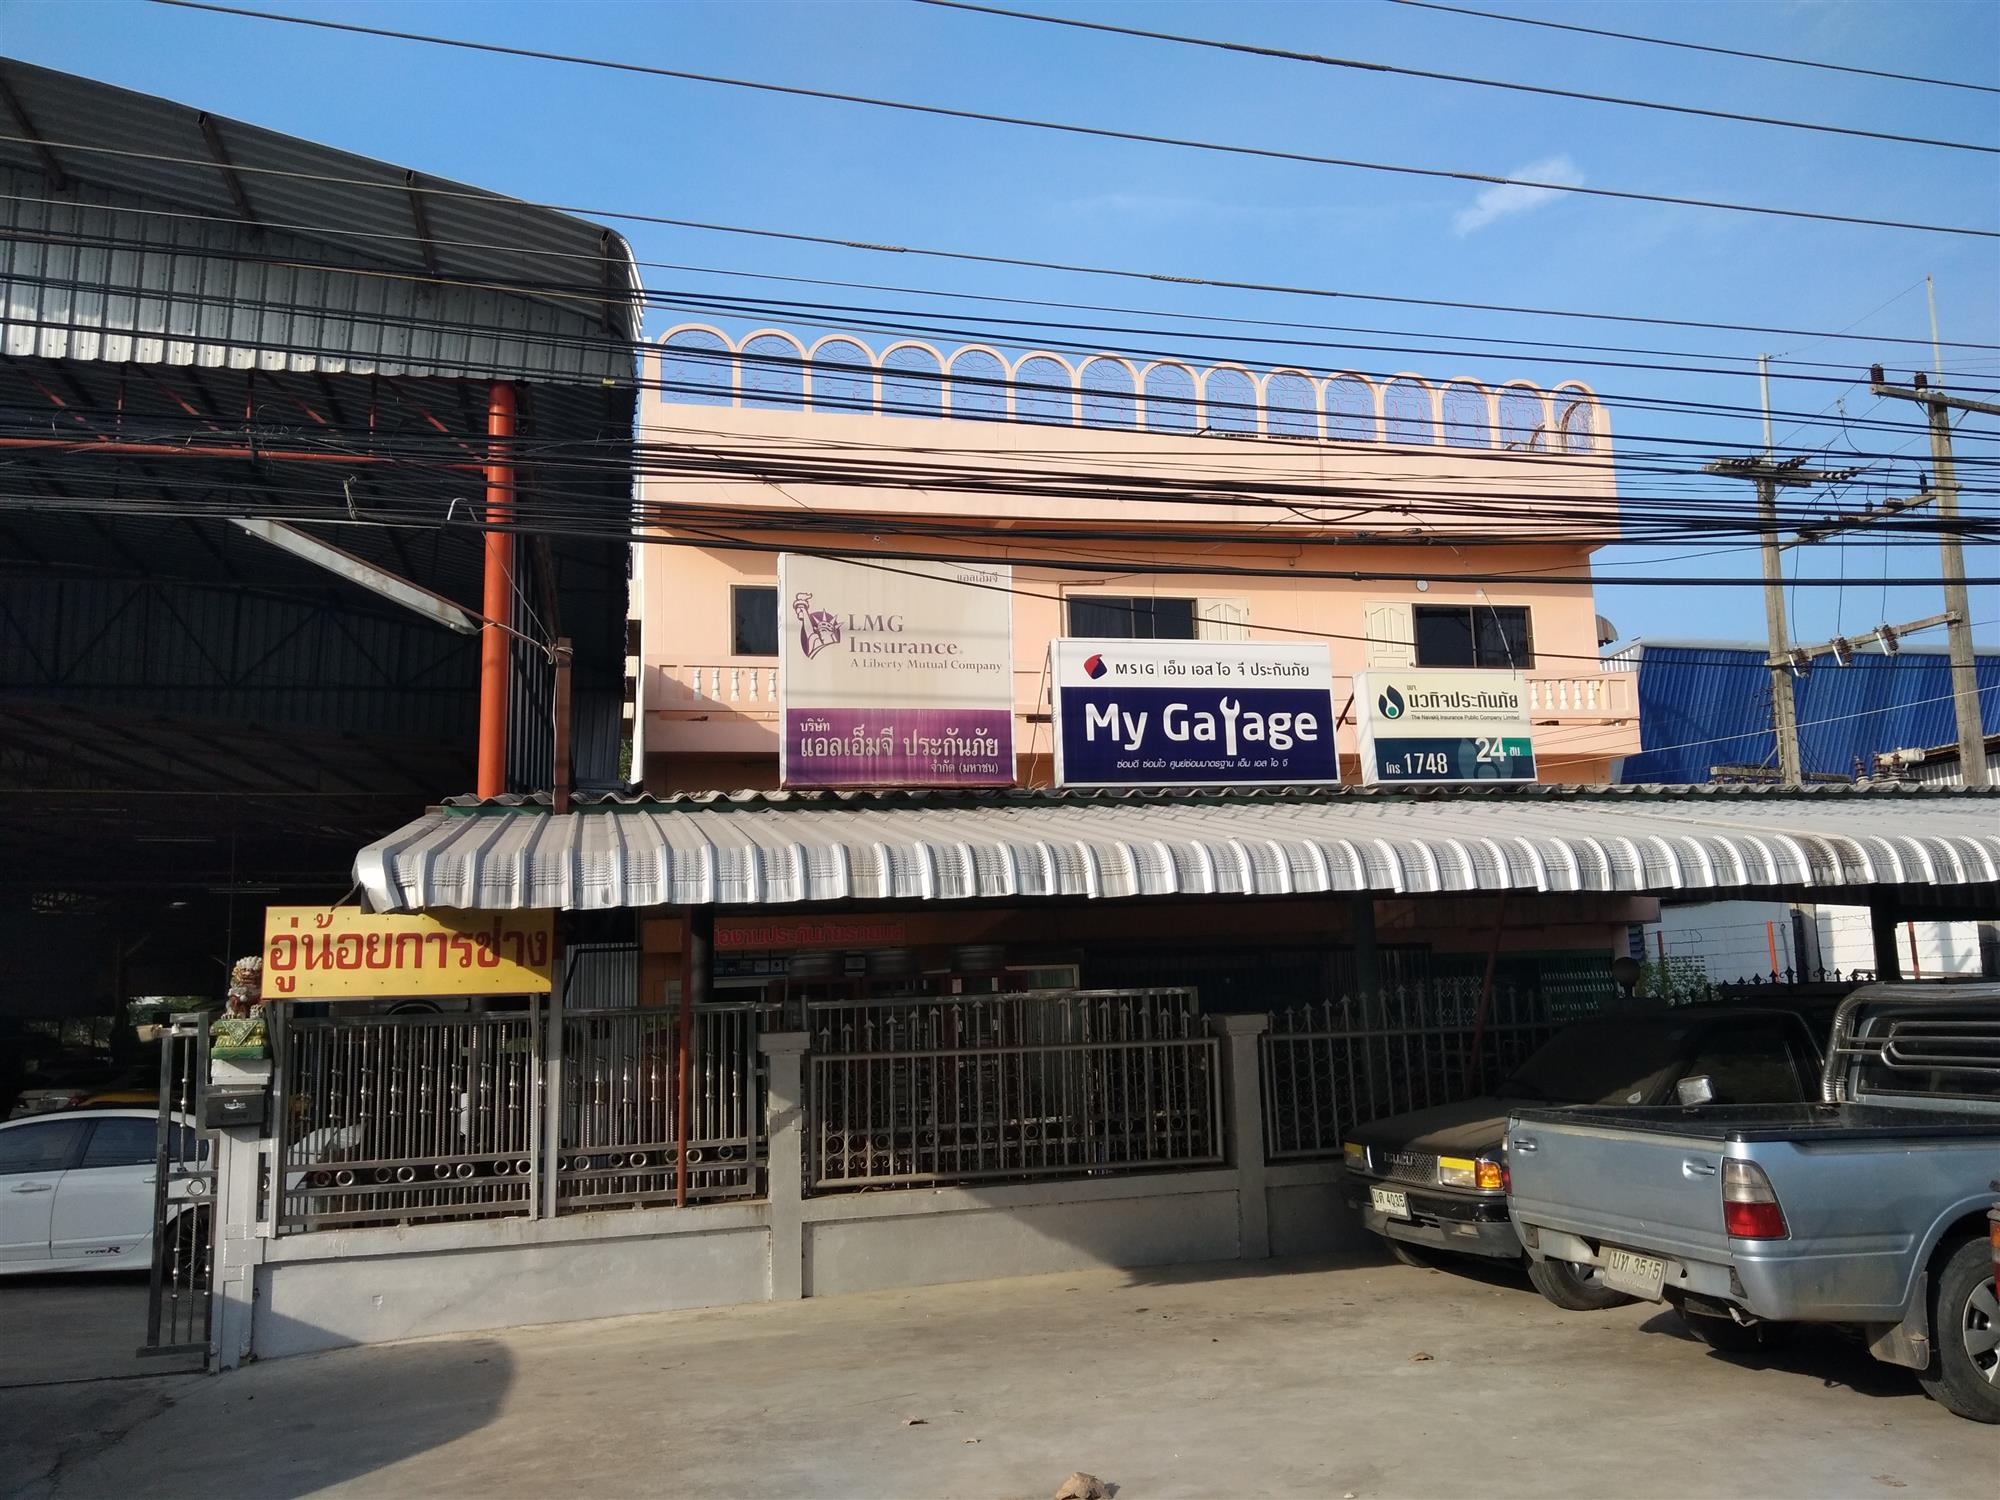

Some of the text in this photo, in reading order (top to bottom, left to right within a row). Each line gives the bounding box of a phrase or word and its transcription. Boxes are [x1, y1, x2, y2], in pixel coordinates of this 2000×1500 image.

[848, 614, 904, 632] LMG
[850, 659, 1002, 673] A Liberty Mutual Company
[1115, 663, 1155, 676] MSIG
[1163, 660, 1310, 677] เอ็ม เอส ไอ จี ประกันภัย
[1409, 691, 1519, 708] นวกิจประกันภัย
[800, 718, 831, 732] บริษัท
[1085, 703, 1148, 751] My
[801, 724, 999, 757] แอลเอ็มจี ประกันภัย
[1475, 736, 1507, 763] 24
[930, 758, 999, 775] จำกัด (มหาชน)
[1403, 752, 1449, 774] 1748
[270, 913, 548, 993] อู่น้อยการช่าง
[1633, 1258, 1661, 1280] 3515
